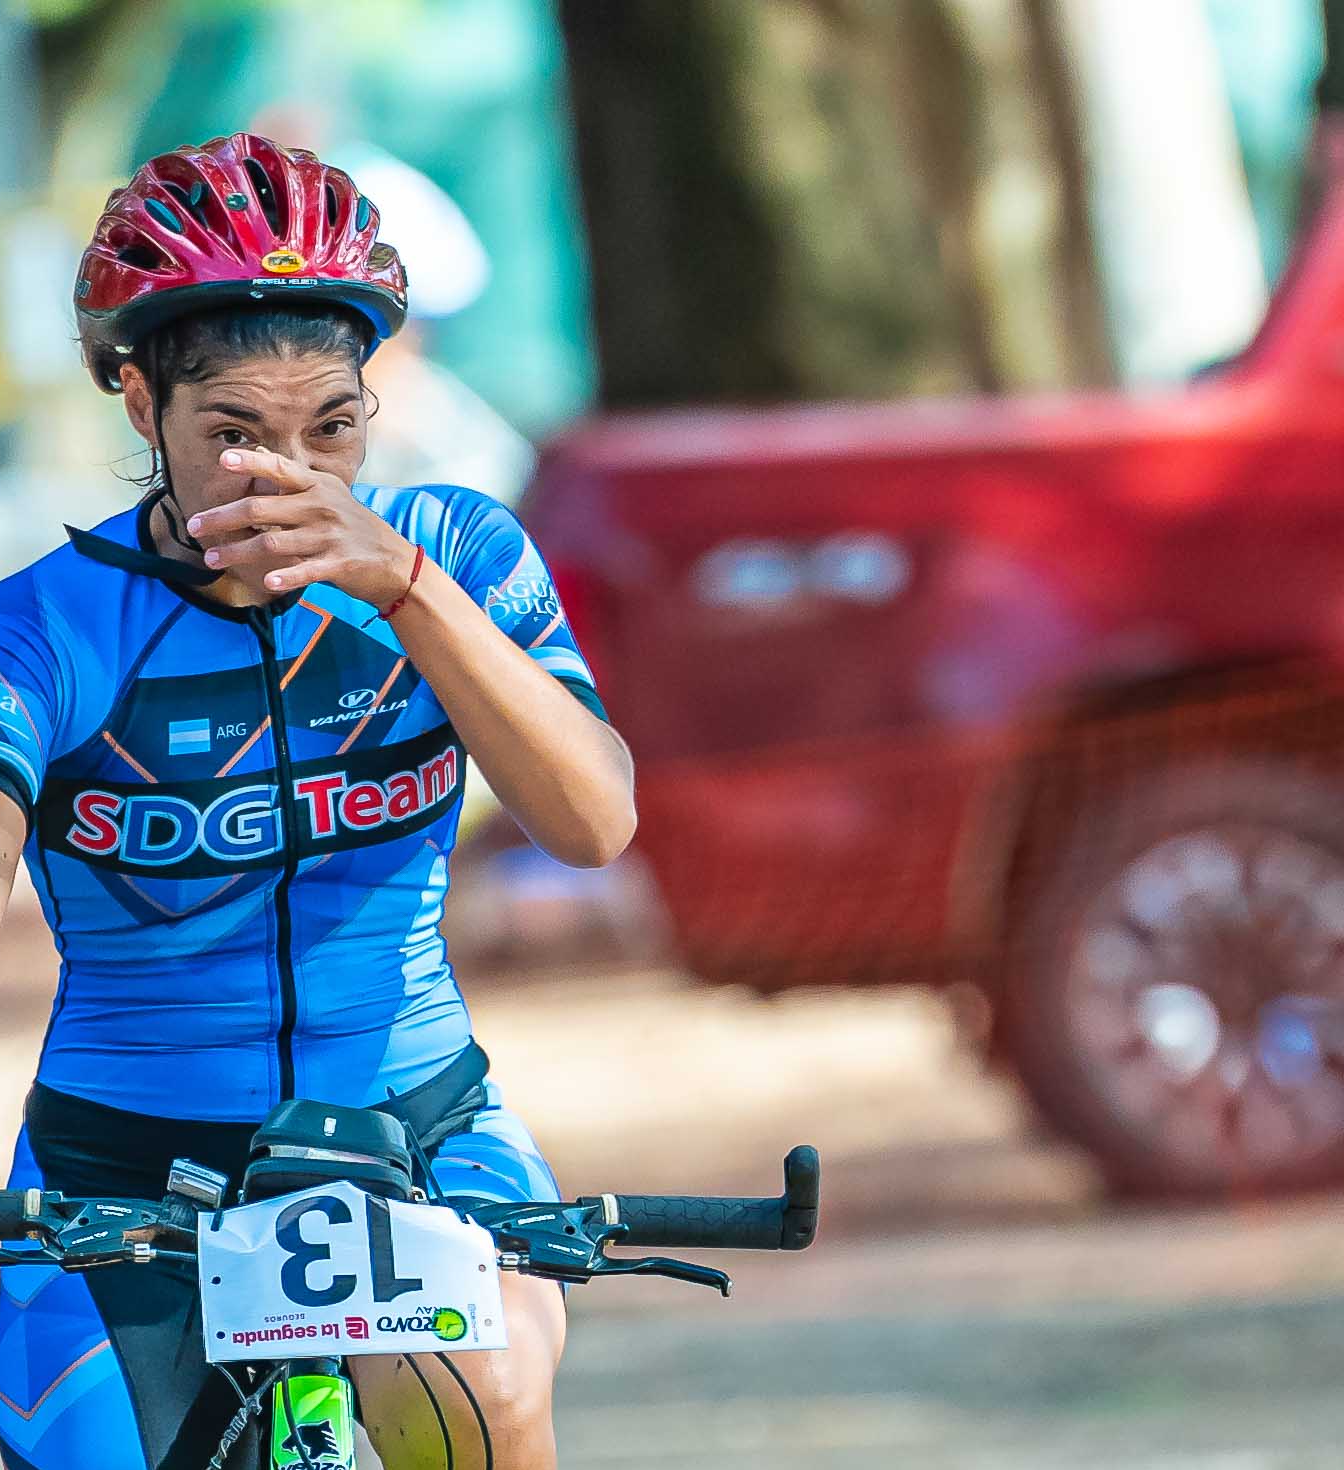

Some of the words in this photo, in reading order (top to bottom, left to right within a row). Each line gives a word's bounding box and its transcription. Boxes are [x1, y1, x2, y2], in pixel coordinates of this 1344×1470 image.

[309, 698, 408, 728] VANDALIA
[216, 722, 247, 739] ARG
[66, 782, 283, 865] SDG
[293, 744, 458, 838] Team
[275, 1194, 423, 1307] 13
[263, 1313, 306, 1323] SEGUROS
[232, 1321, 317, 1346] segunda
[318, 1322, 340, 1341] la
